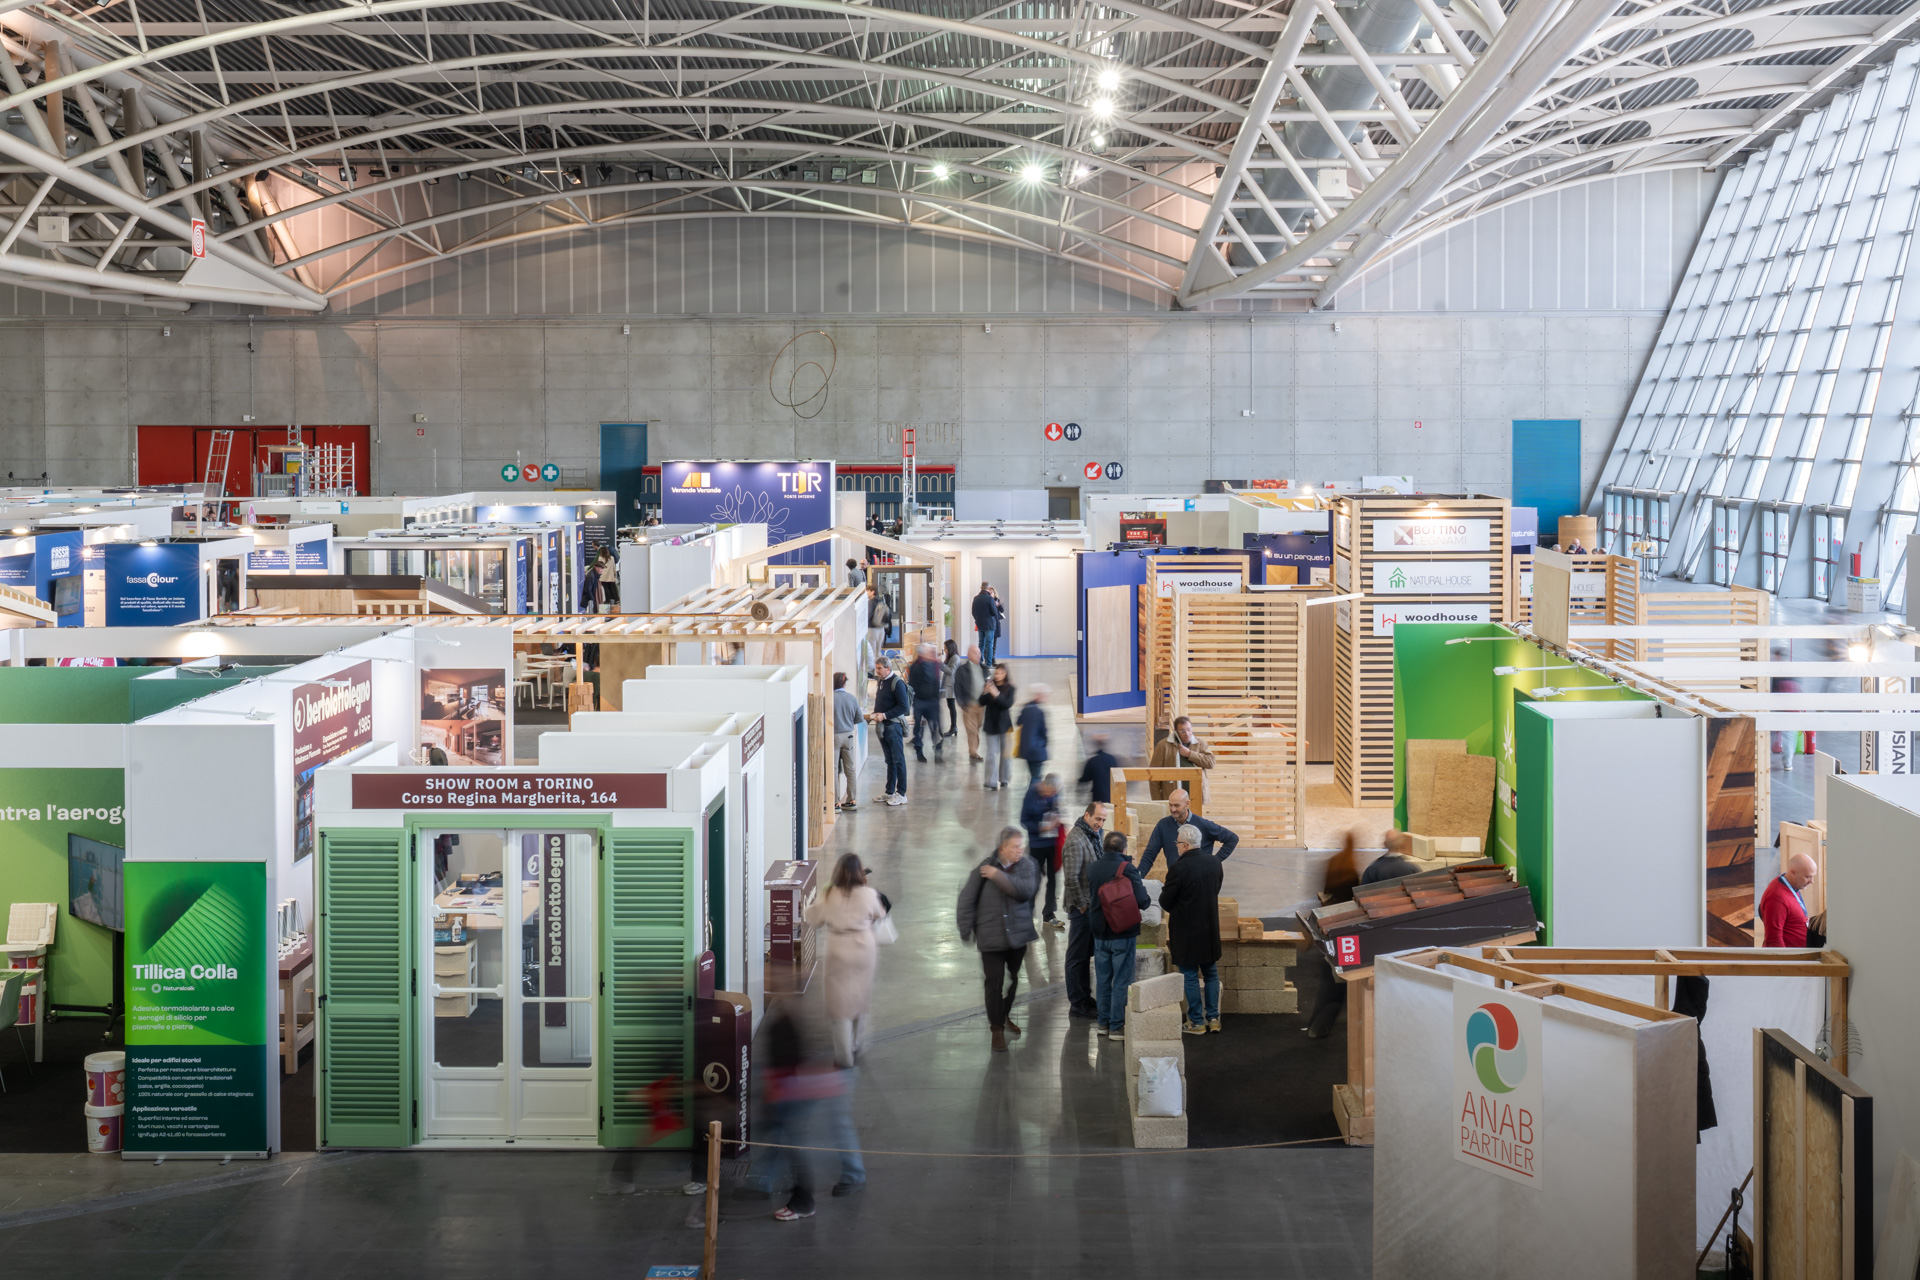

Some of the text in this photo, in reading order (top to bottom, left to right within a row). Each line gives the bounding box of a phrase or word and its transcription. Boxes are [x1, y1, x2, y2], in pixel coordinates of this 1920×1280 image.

[1414, 526, 1466, 534] BOTTINO
[1414, 536, 1466, 545] LEGNAMI
[1294, 554, 1323, 562] parquet
[1410, 576, 1472, 586] NATURAL HOUSE
[1405, 613, 1478, 621] woodhouse
[306, 678, 370, 727] bertolottolegno
[425, 778, 594, 790] SHOW ROOM a TORINO
[402, 792, 618, 806] Corso Regina Margherita, 164
[549, 836, 564, 966] bertolottolegno
[1341, 937, 1356, 954] B
[132, 964, 238, 980] Tillica Colla
[739, 1045, 749, 1151] bertolottolegno
[1462, 1091, 1534, 1145] ANAB
[1461, 1126, 1534, 1172] PARTNER
